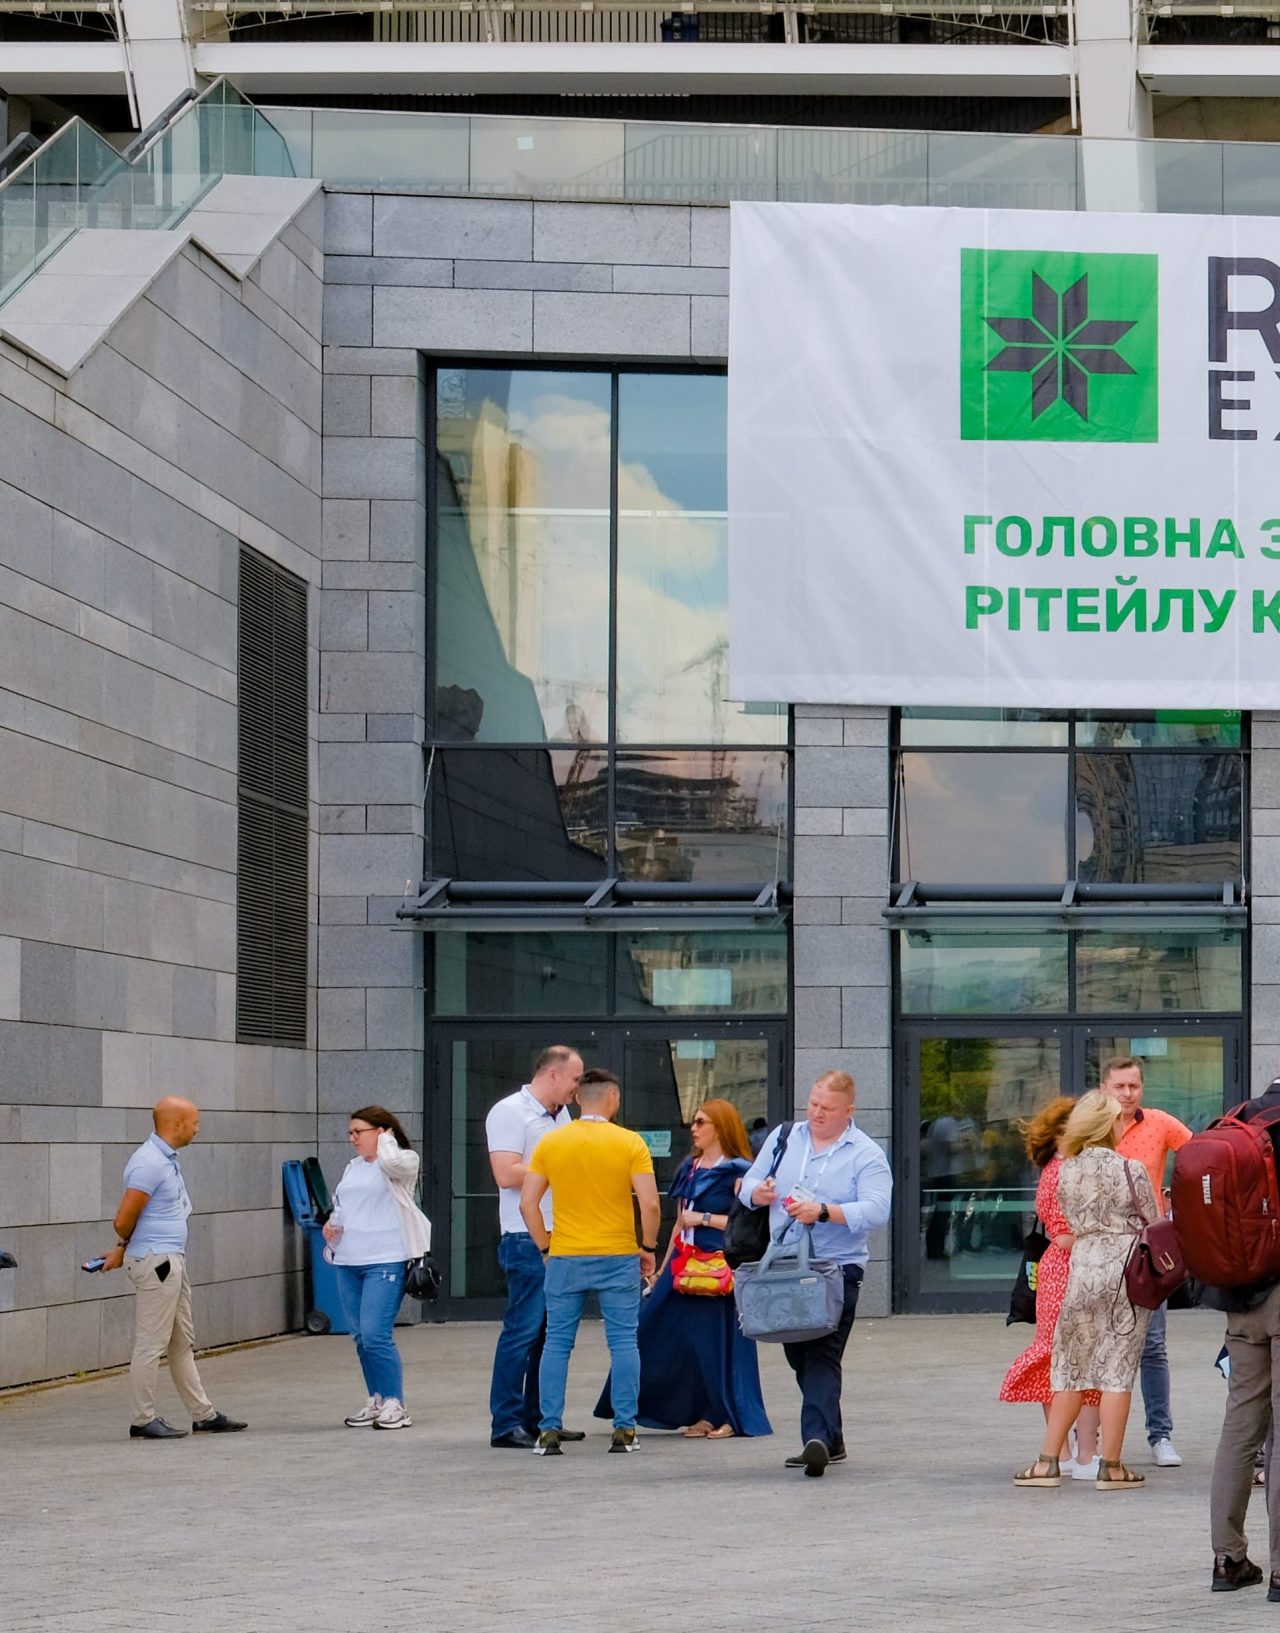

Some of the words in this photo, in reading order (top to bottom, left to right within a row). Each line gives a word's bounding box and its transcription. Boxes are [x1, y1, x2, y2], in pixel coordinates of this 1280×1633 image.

[963, 514, 1245, 560] ГОЛОВНА
[965, 576, 1236, 633] РІТЕЙЛУ
[1202, 1174, 1212, 1205] THULE
